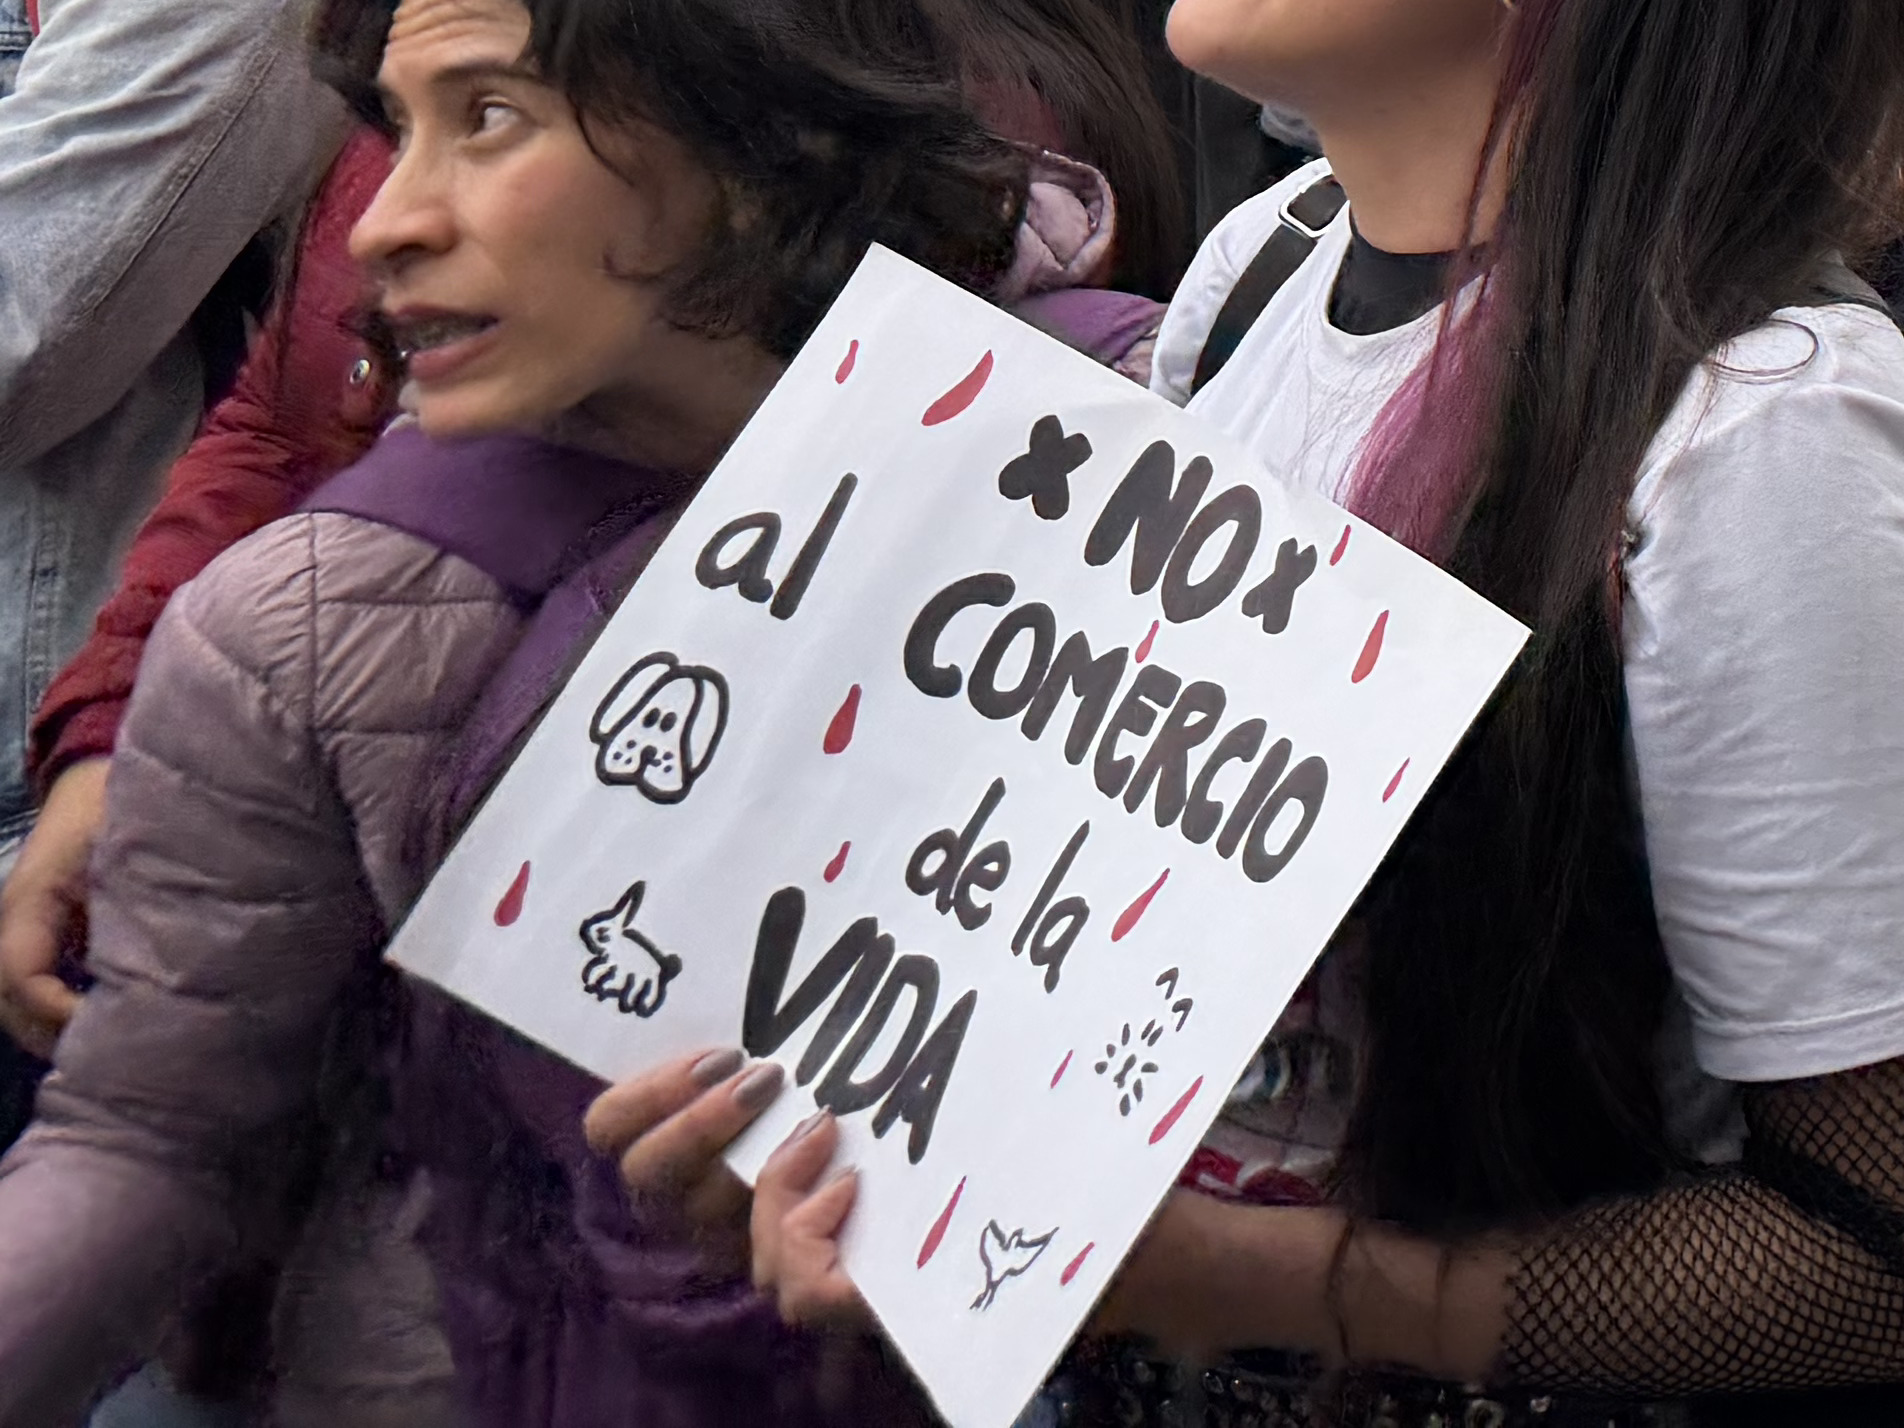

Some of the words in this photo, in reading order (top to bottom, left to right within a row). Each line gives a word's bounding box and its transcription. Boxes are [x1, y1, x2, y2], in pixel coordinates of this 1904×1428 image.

[694, 472, 858, 620] al
[1085, 439, 1262, 624] NO
[902, 572, 1329, 884] COMERCIO
[905, 776, 1012, 931] de
[1010, 819, 1093, 993] la
[739, 884, 979, 1165] VIDA
